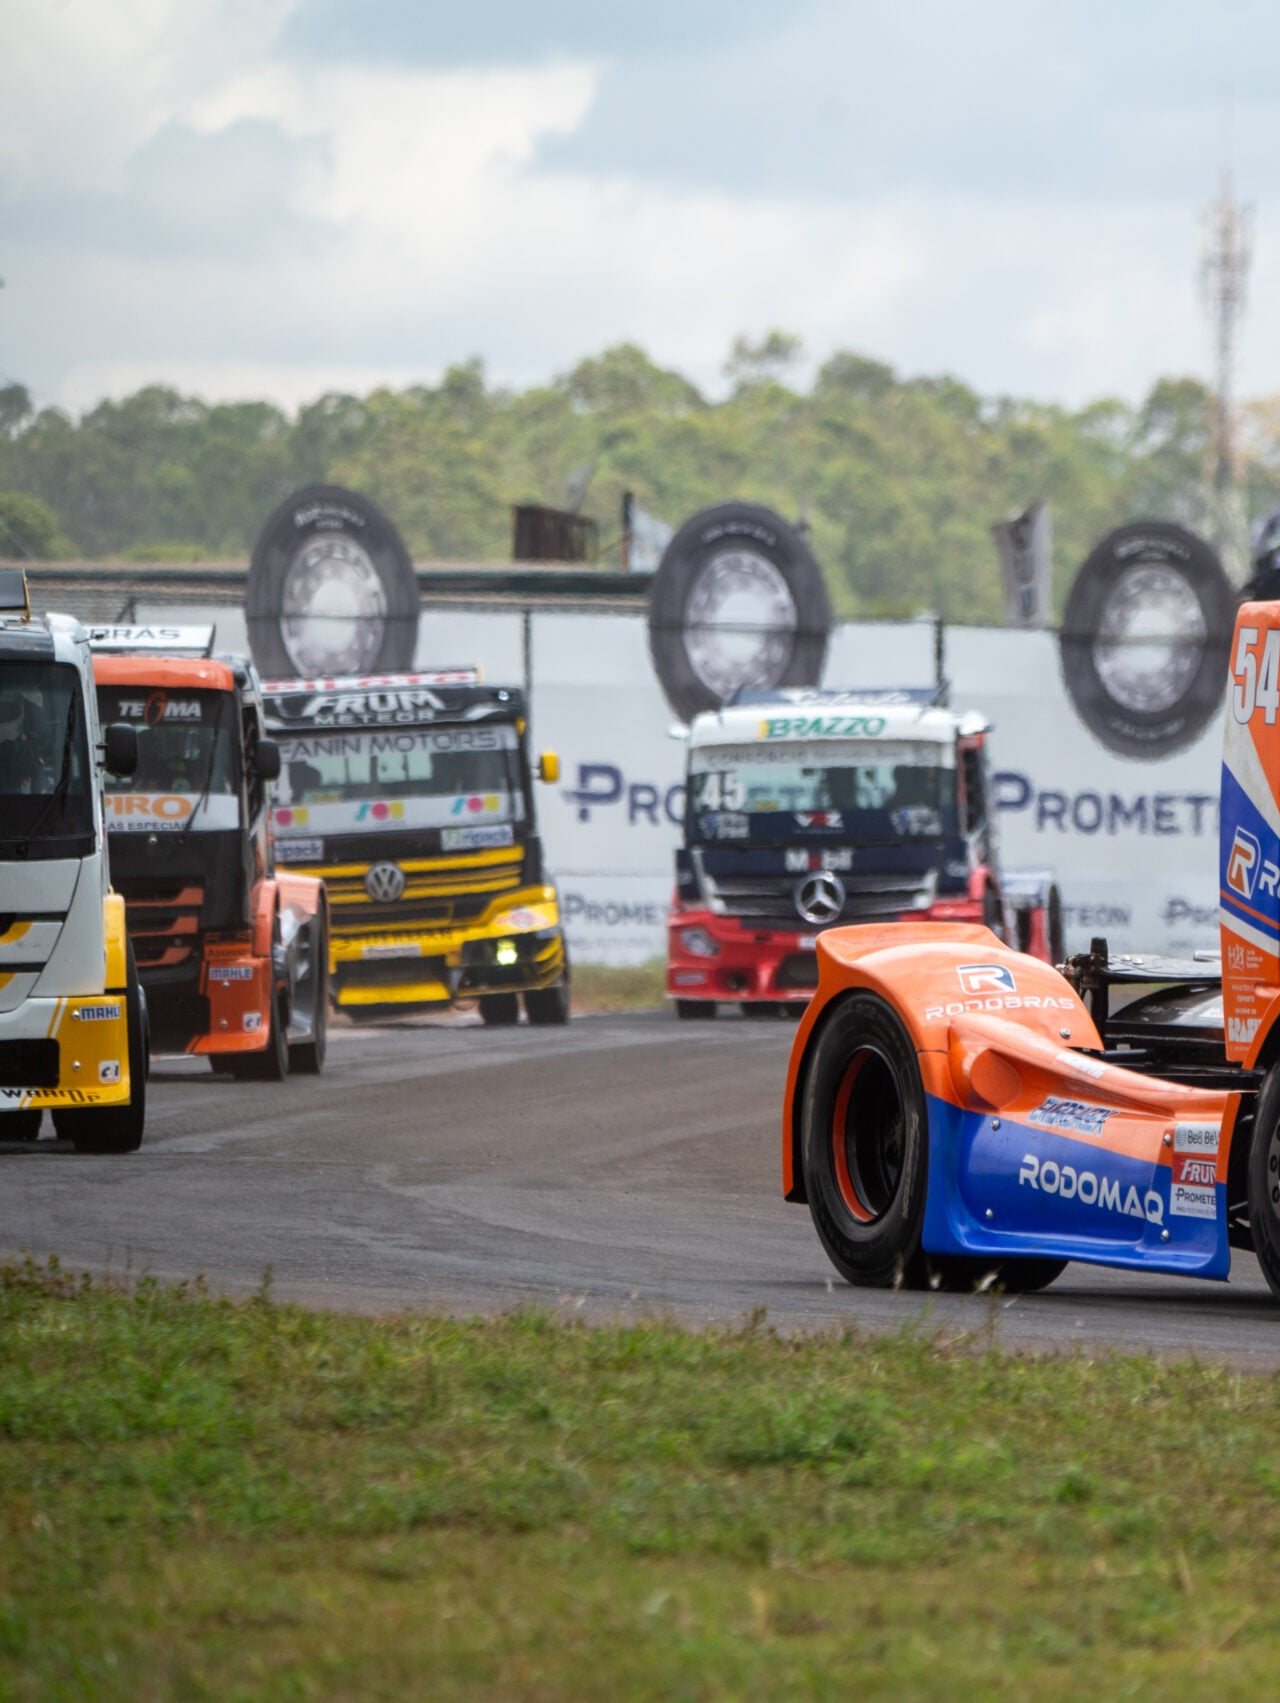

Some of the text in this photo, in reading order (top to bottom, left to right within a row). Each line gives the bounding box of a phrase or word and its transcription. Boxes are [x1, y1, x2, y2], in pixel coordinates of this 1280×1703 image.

[302, 690, 446, 717] FRUM
[314, 710, 435, 726] METEOR
[370, 730, 498, 754] MOTORS
[991, 770, 1221, 836] PROMET
[127, 821, 193, 832] ESPECIAI
[81, 1006, 119, 1020] MAHL
[925, 996, 1075, 1021] RODOBRAS
[1019, 1154, 1164, 1226] RODOMAQ
